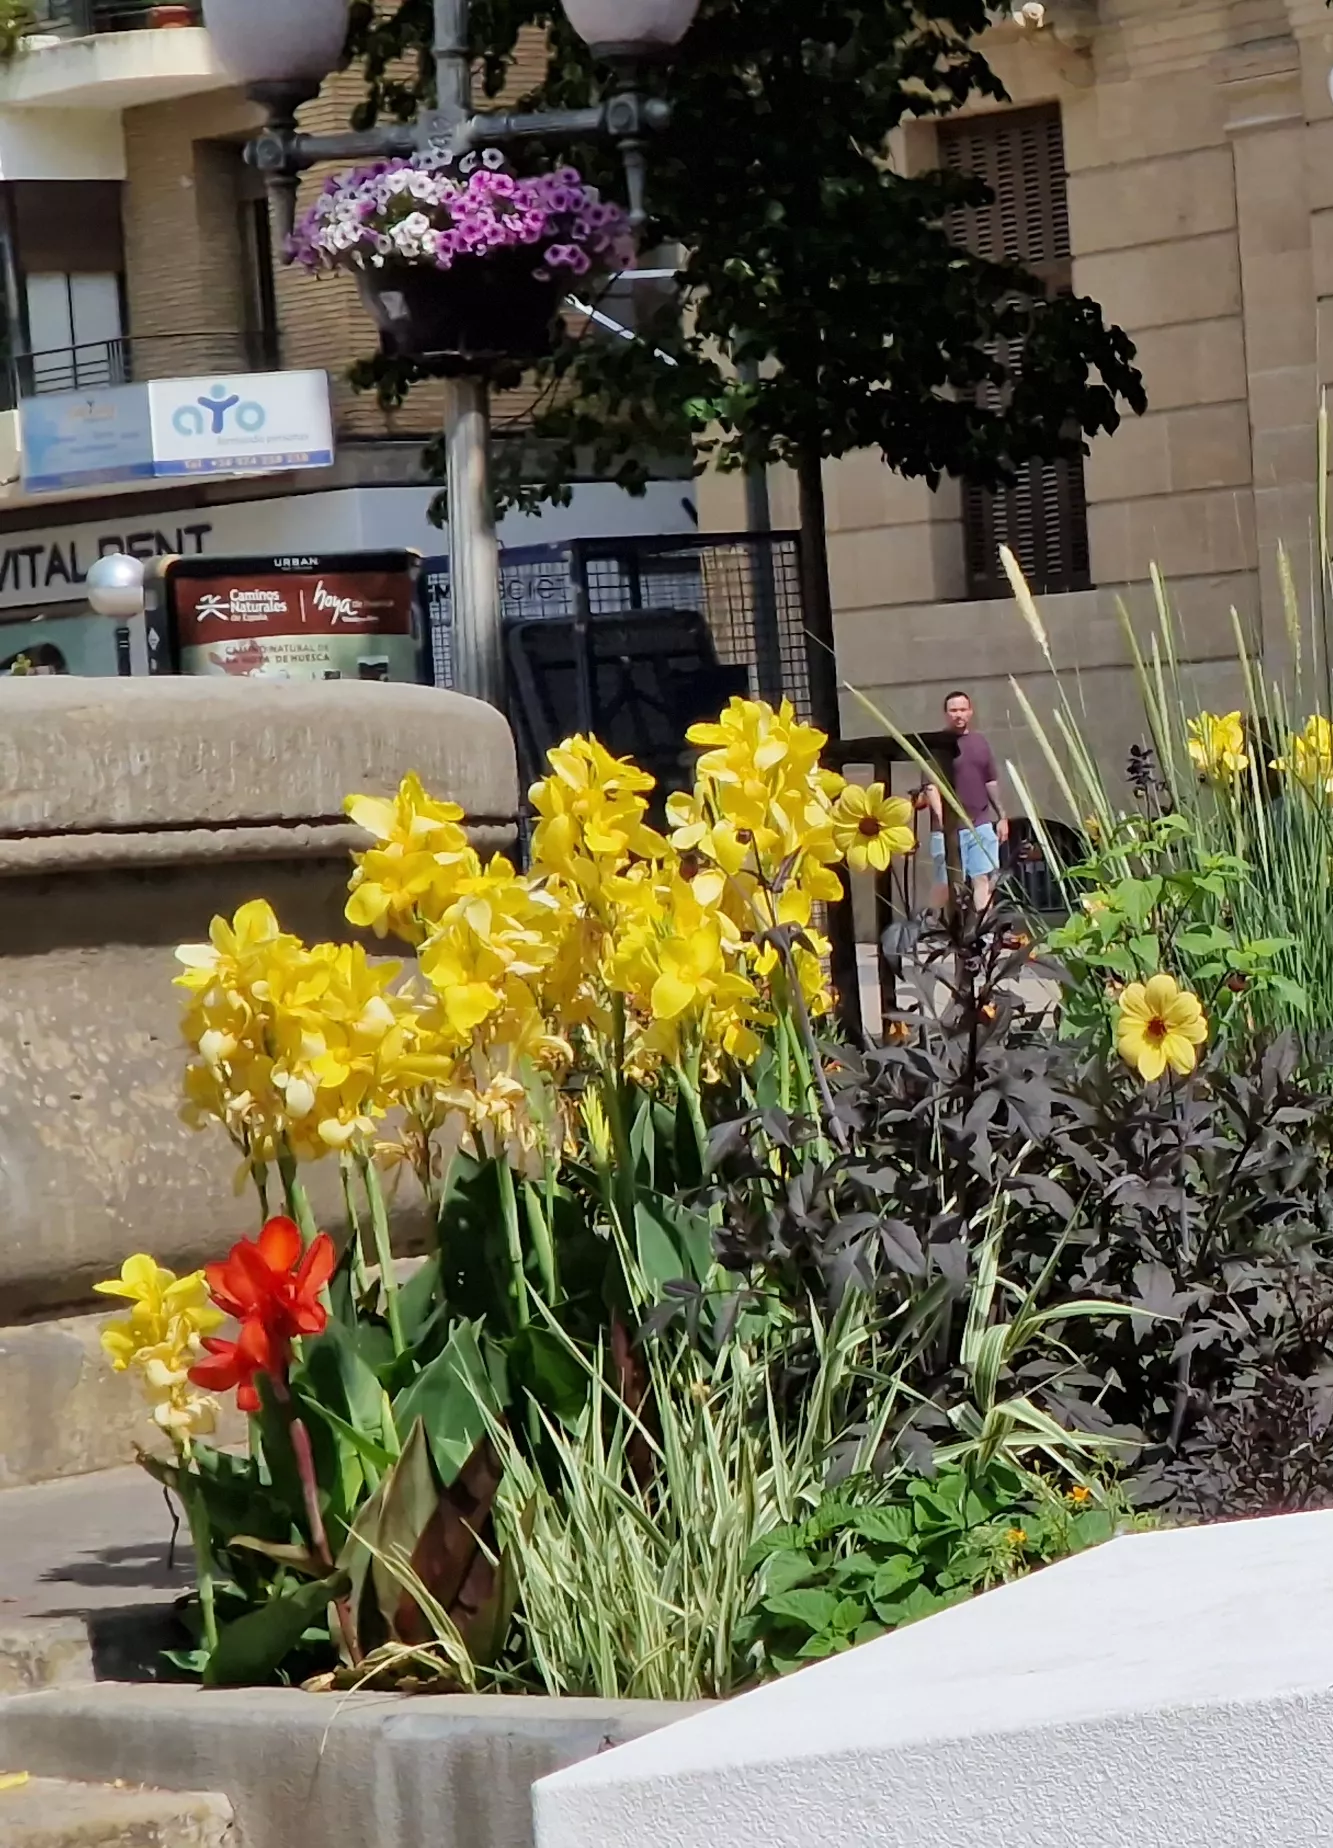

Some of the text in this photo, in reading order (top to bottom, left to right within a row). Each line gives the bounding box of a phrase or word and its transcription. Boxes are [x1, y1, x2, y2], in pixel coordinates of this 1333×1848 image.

[274, 557, 319, 568] URBAN
[230, 588, 280, 601] Caminos
[230, 600, 288, 613] Naturales
[313, 580, 358, 625] hoya
[268, 643, 316, 653] NATURAL
[275, 655, 288, 663] DE
[290, 653, 330, 662] HUESCA
